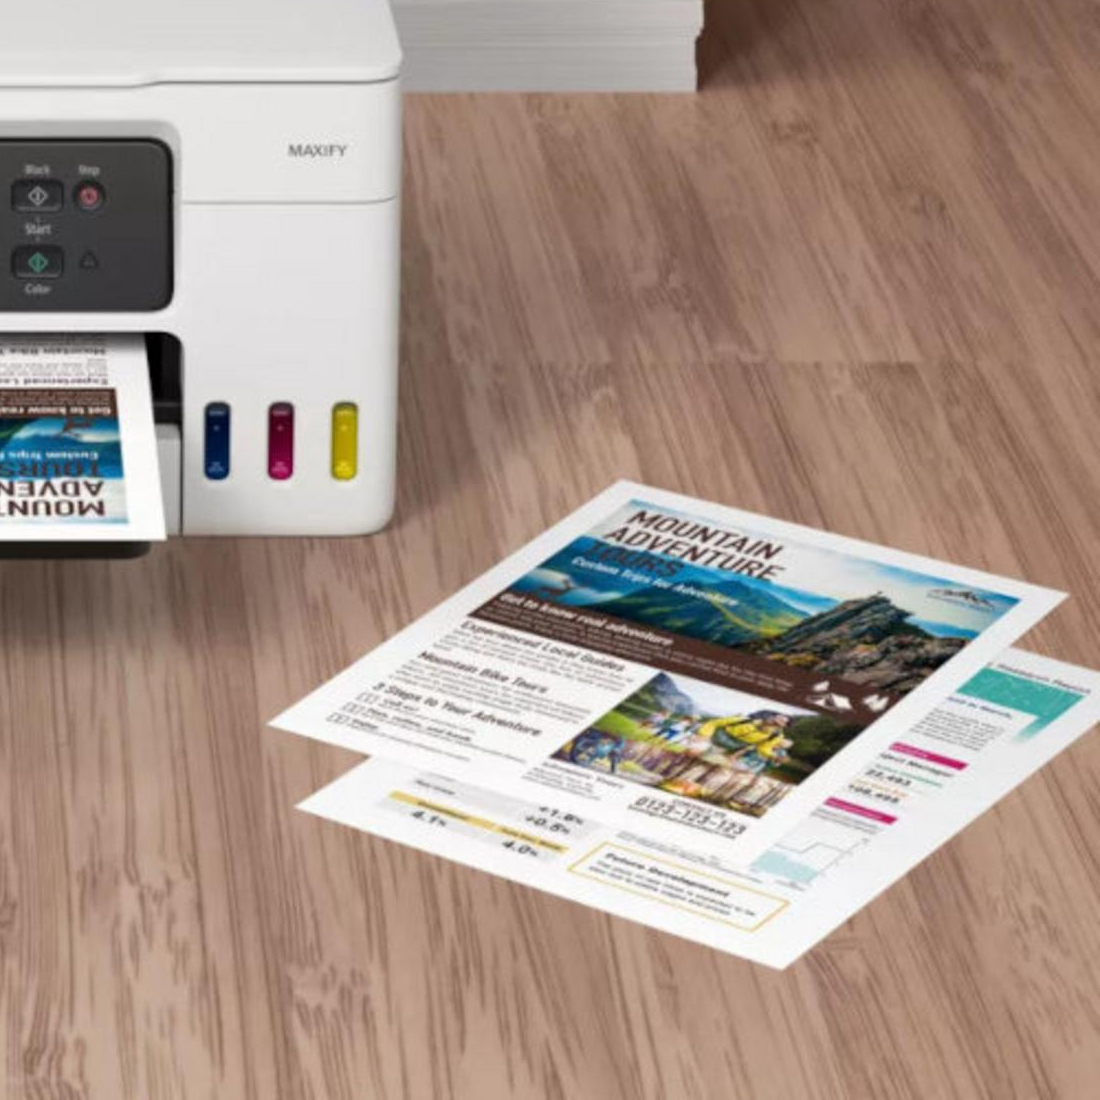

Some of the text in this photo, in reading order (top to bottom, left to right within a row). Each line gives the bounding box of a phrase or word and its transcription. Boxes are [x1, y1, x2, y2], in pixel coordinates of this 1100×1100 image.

[288, 143, 347, 157] MAXIFY
[24, 164, 50, 175] Black
[78, 164, 100, 176] Stop
[25, 222, 52, 235] Start
[24, 283, 51, 294] Color
[8, 450, 42, 460] Trips
[45, 451, 99, 460] Custom
[627, 510, 783, 560] MOUNTAIN
[586, 540, 685, 577] TOURS
[603, 526, 785, 580] ADVENTURE
[571, 556, 739, 606] Custom Trips for Adventure
[542, 641, 579, 658] Local
[417, 651, 550, 694] Mountain Bike Tours
[472, 709, 542, 737] Adventure
[635, 796, 747, 835] 0123-123-123
